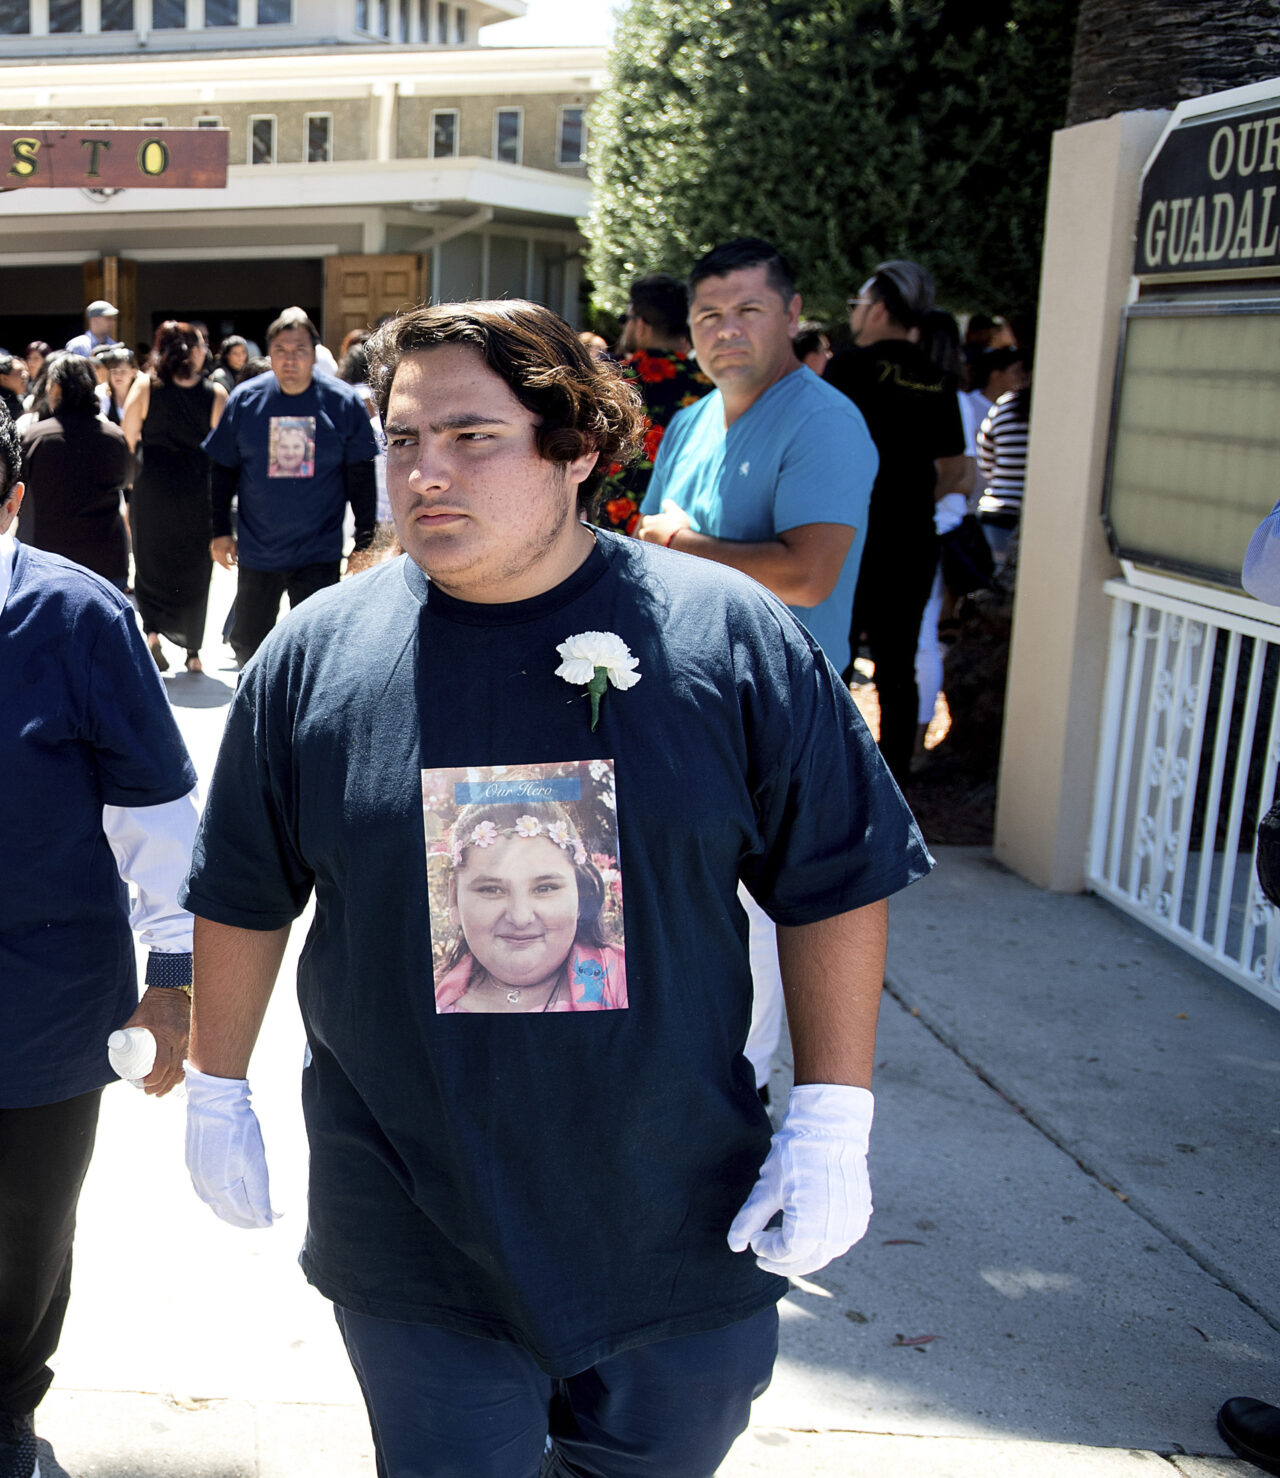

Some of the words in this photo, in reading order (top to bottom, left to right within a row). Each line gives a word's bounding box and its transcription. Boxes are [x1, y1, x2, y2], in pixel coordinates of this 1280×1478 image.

[1208, 116, 1280, 181] OUR
[1144, 186, 1280, 267] GUADAL
[484, 783, 512, 798] Our
[517, 781, 552, 797] Hero
